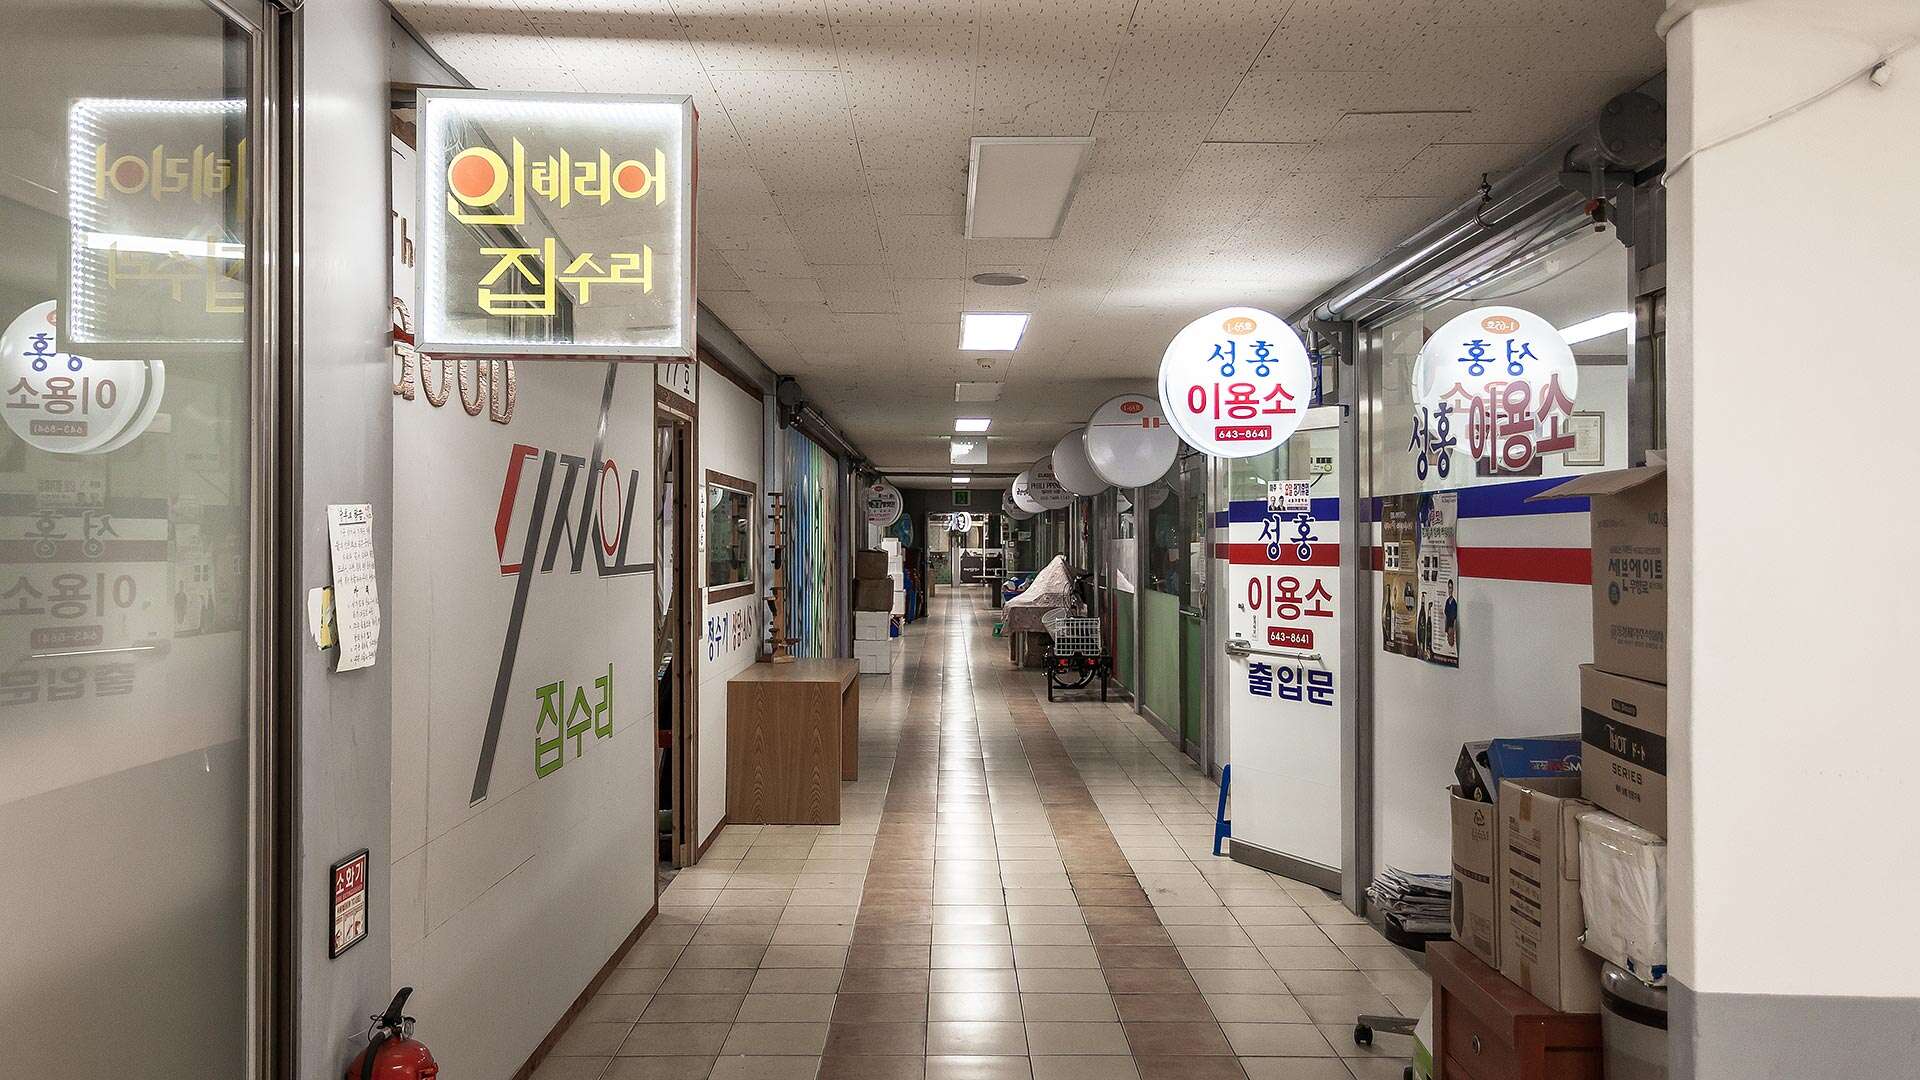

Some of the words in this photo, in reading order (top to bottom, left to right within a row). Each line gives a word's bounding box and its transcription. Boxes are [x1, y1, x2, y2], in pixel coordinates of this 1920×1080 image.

[447, 137, 665, 226] 인테리어
[478, 238, 653, 316] 집수리
[1187, 382, 1296, 420] 이용소
[1468, 373, 1576, 472] 이용소
[1218, 428, 1269, 439] 643-8641
[1408, 401, 1458, 481] 성홍
[1248, 575, 1334, 621] 이용소
[707, 612, 729, 662] 정수기
[1270, 631, 1310, 644] 643-8641
[1248, 662, 1335, 707] 출입문
[534, 663, 614, 779] 집수리
[1611, 762, 1643, 785] SERIES
[336, 861, 364, 896] 소화기
